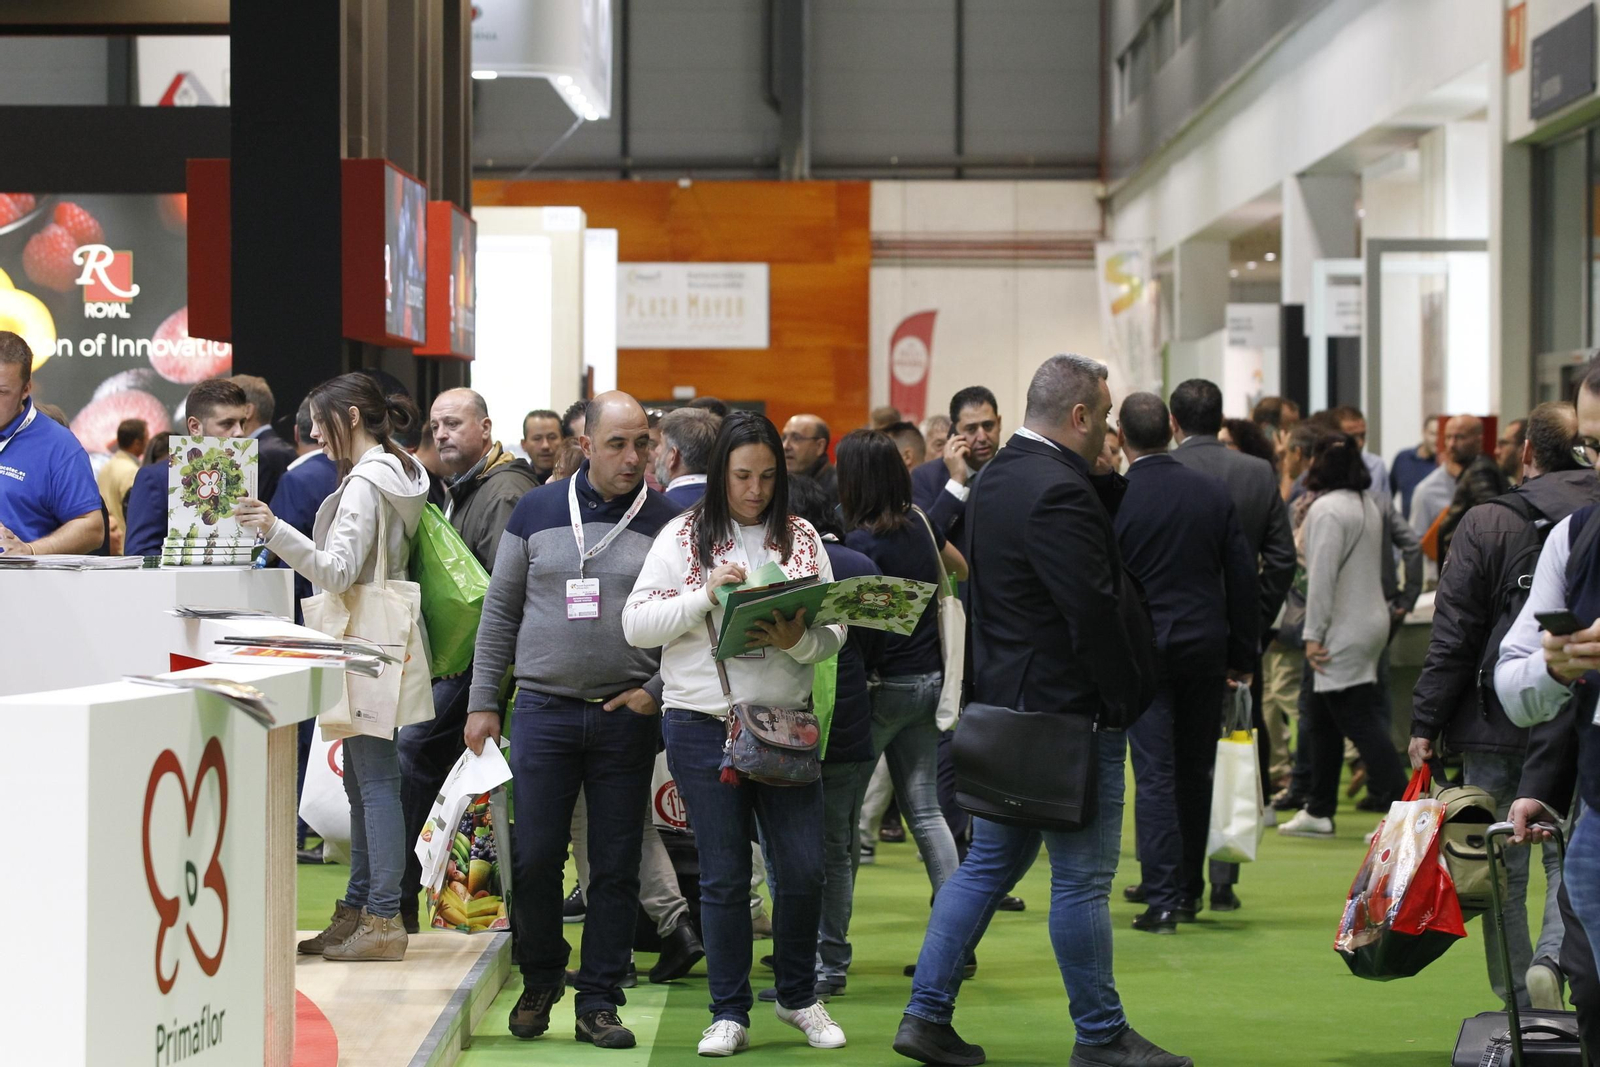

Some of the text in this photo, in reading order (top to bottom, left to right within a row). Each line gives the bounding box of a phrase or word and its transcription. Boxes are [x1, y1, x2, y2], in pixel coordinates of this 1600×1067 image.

[83, 302, 131, 319] ROYAL
[78, 332, 107, 357] of
[111, 333, 232, 357] Innovatio
[156, 1003, 226, 1067] Primaflor
